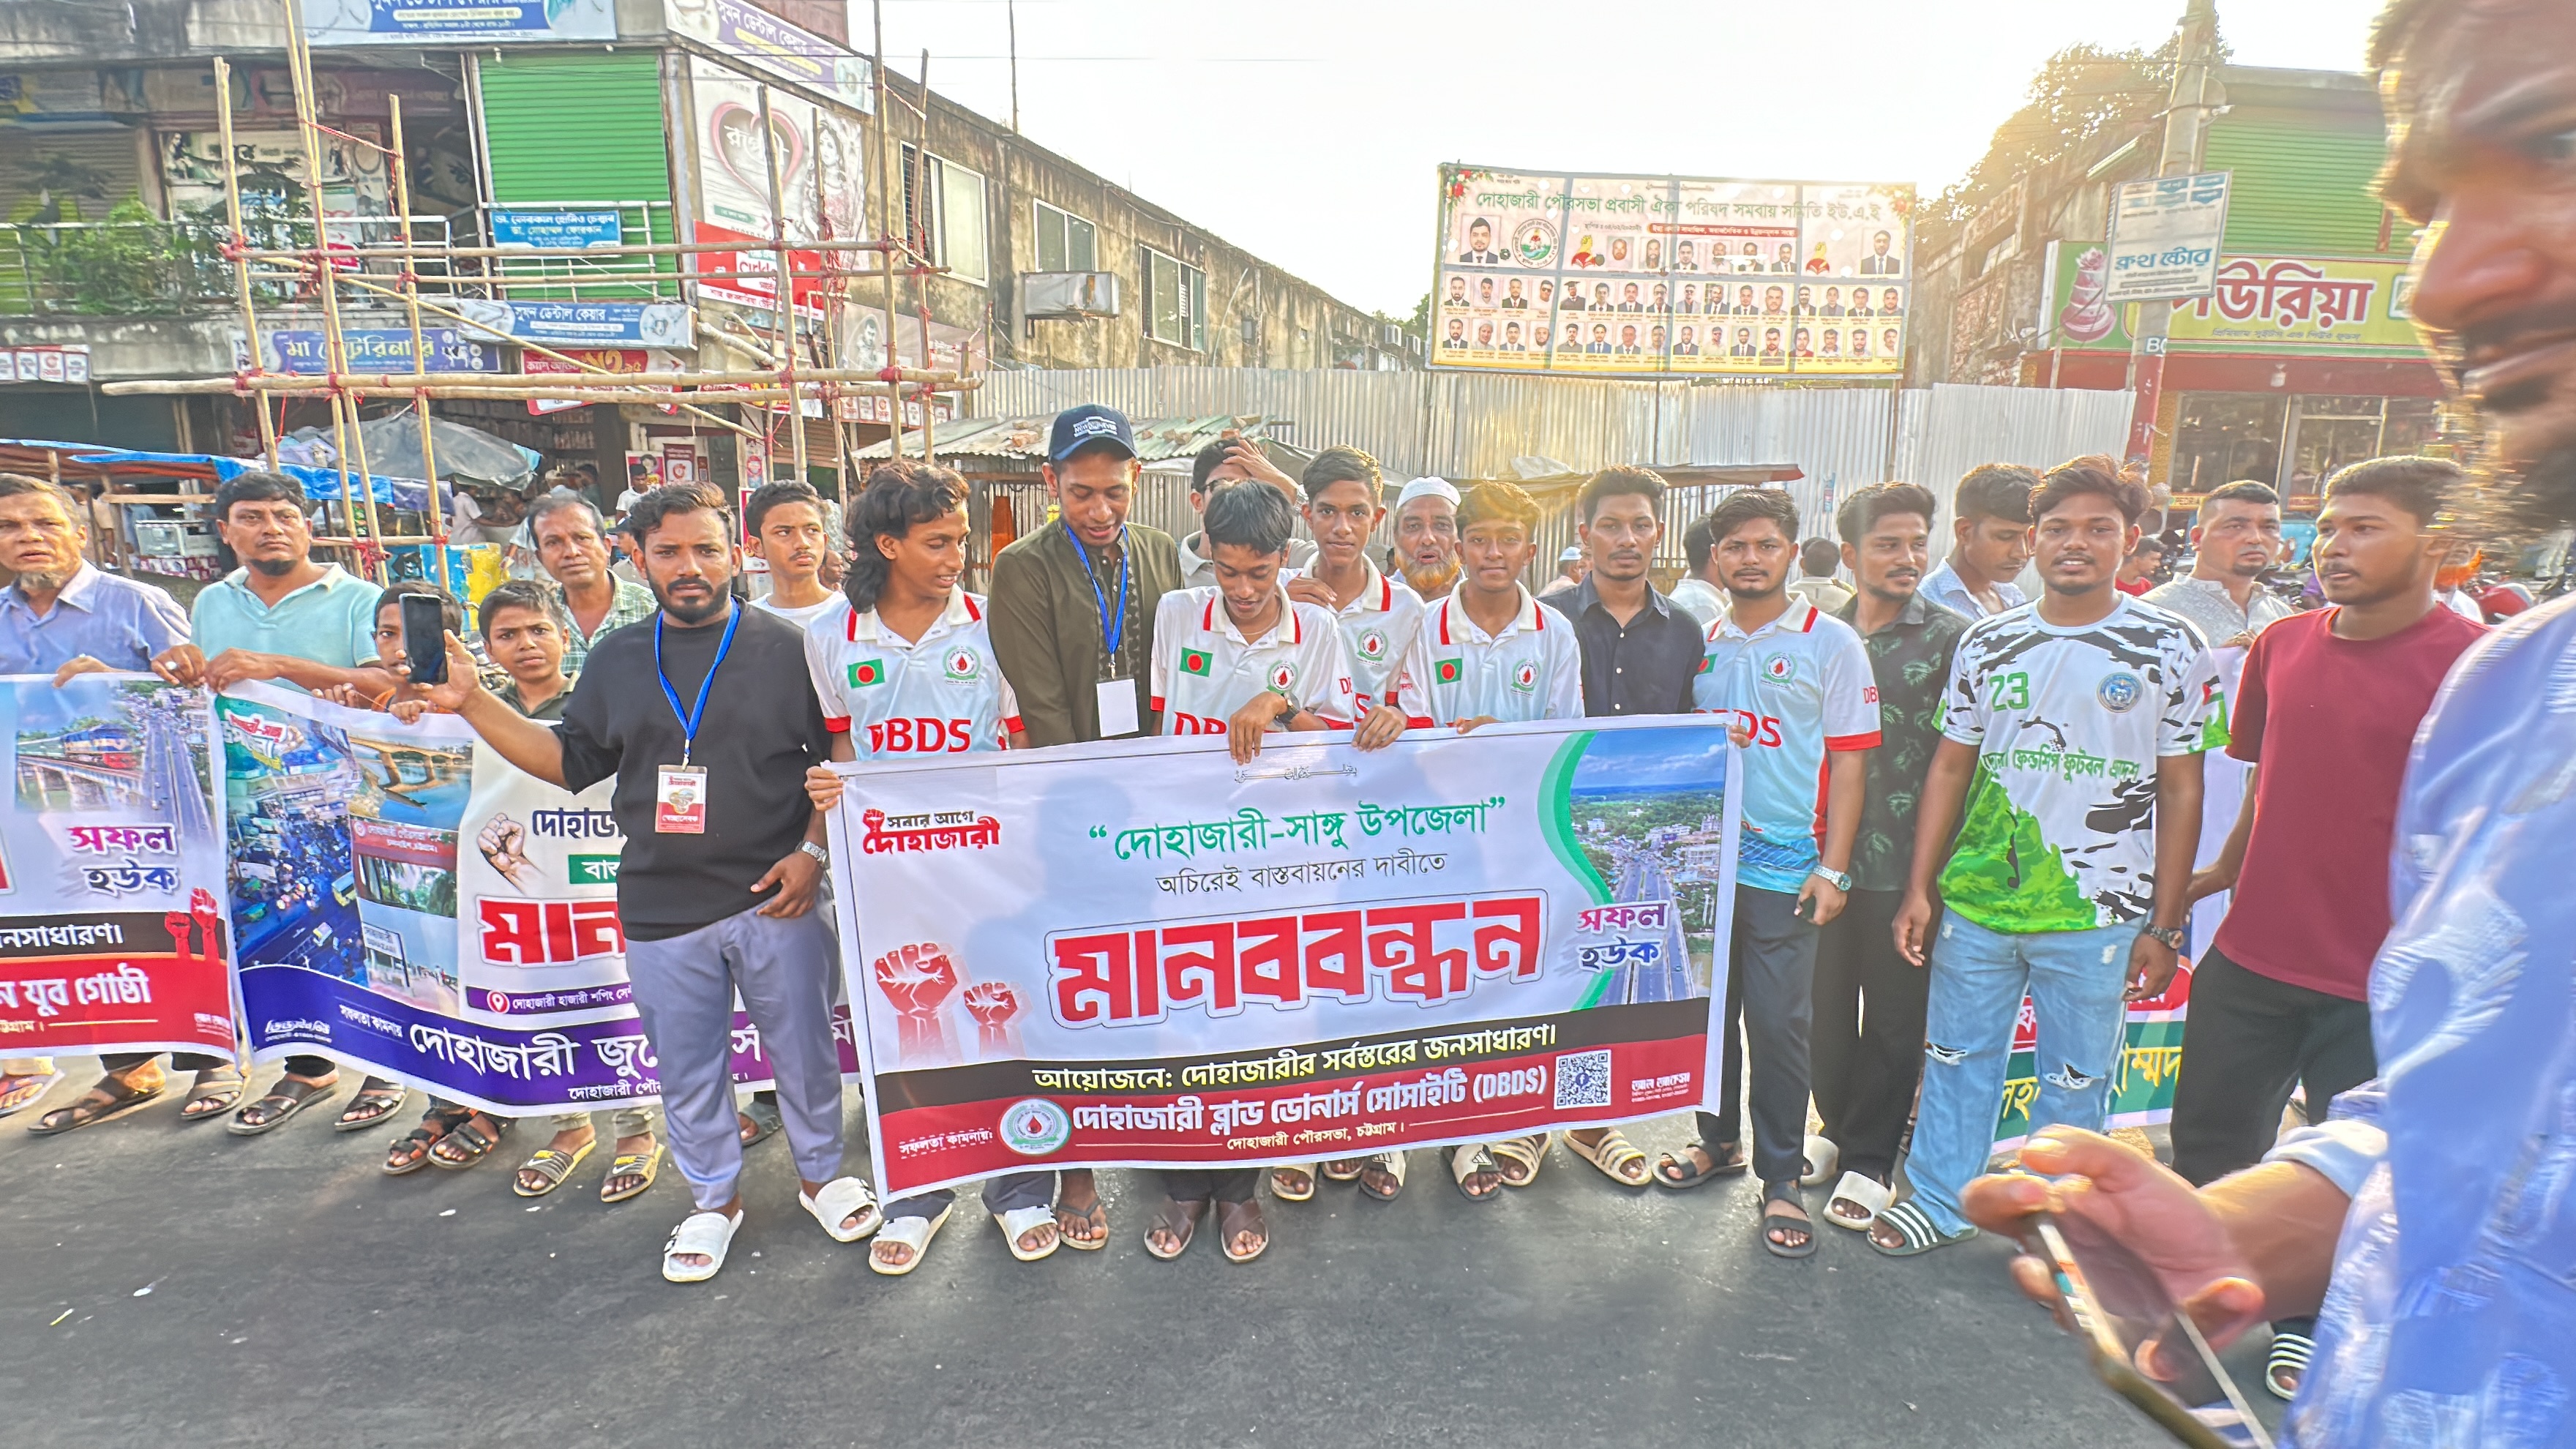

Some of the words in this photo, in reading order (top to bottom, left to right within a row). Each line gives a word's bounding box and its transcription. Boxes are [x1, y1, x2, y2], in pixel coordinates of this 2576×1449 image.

[1476, 190, 1540, 210] দোহাজারী
[1545, 192, 1601, 213] পৌরসভা
[1606, 193, 1647, 214] প্রবাসী
[1685, 198, 1729, 217] পরিষদ
[1734, 203, 1778, 219] সমবায়
[1781, 201, 1823, 219] সমিতি
[284, 340, 310, 357] মা
[1989, 671, 2029, 712] 23
[863, 816, 1000, 855] দোহাজারী
[887, 814, 930, 828] সবার
[934, 810, 974, 825] আগে
[67, 825, 173, 852] সফল
[80, 857, 175, 894] হউক
[1155, 864, 1242, 896] অচিরেই
[1248, 858, 1366, 888] বাস্তবায়নের
[1373, 847, 1448, 877] দাবীতে
[1577, 902, 1668, 931] সফল
[1054, 896, 1540, 1022] মানববন্ধন
[1579, 935, 1660, 970] হউক
[20, 978, 70, 1017] যুব
[75, 962, 151, 1006] গোষ্ঠী
[512, 993, 555, 1010] দোহাজারী
[558, 991, 588, 1006] হাজারী
[410, 1023, 581, 1081] দোহাজারী
[1181, 1048, 1317, 1088] দোহাজারীর
[1322, 1041, 1418, 1071] সর্বস্তরের
[1423, 1023, 1557, 1060] জনসাধারণ।
[568, 1080, 632, 1100] দোহাজারী
[1073, 1096, 1205, 1133] দোহাজারী
[1208, 1098, 1265, 1137] ব্লাড
[1271, 1081, 1364, 1123] ডোনার্স
[1366, 1068, 1468, 1113] সোসাইটি
[1472, 1065, 1548, 1105] (DBDS)
[899, 1137, 944, 1155] সফলতা
[1227, 1131, 1289, 1151] দোহাজারী
[1293, 1126, 1352, 1147] পৌরসভা,
[1356, 1121, 1397, 1139] চট্টগ্রাম
